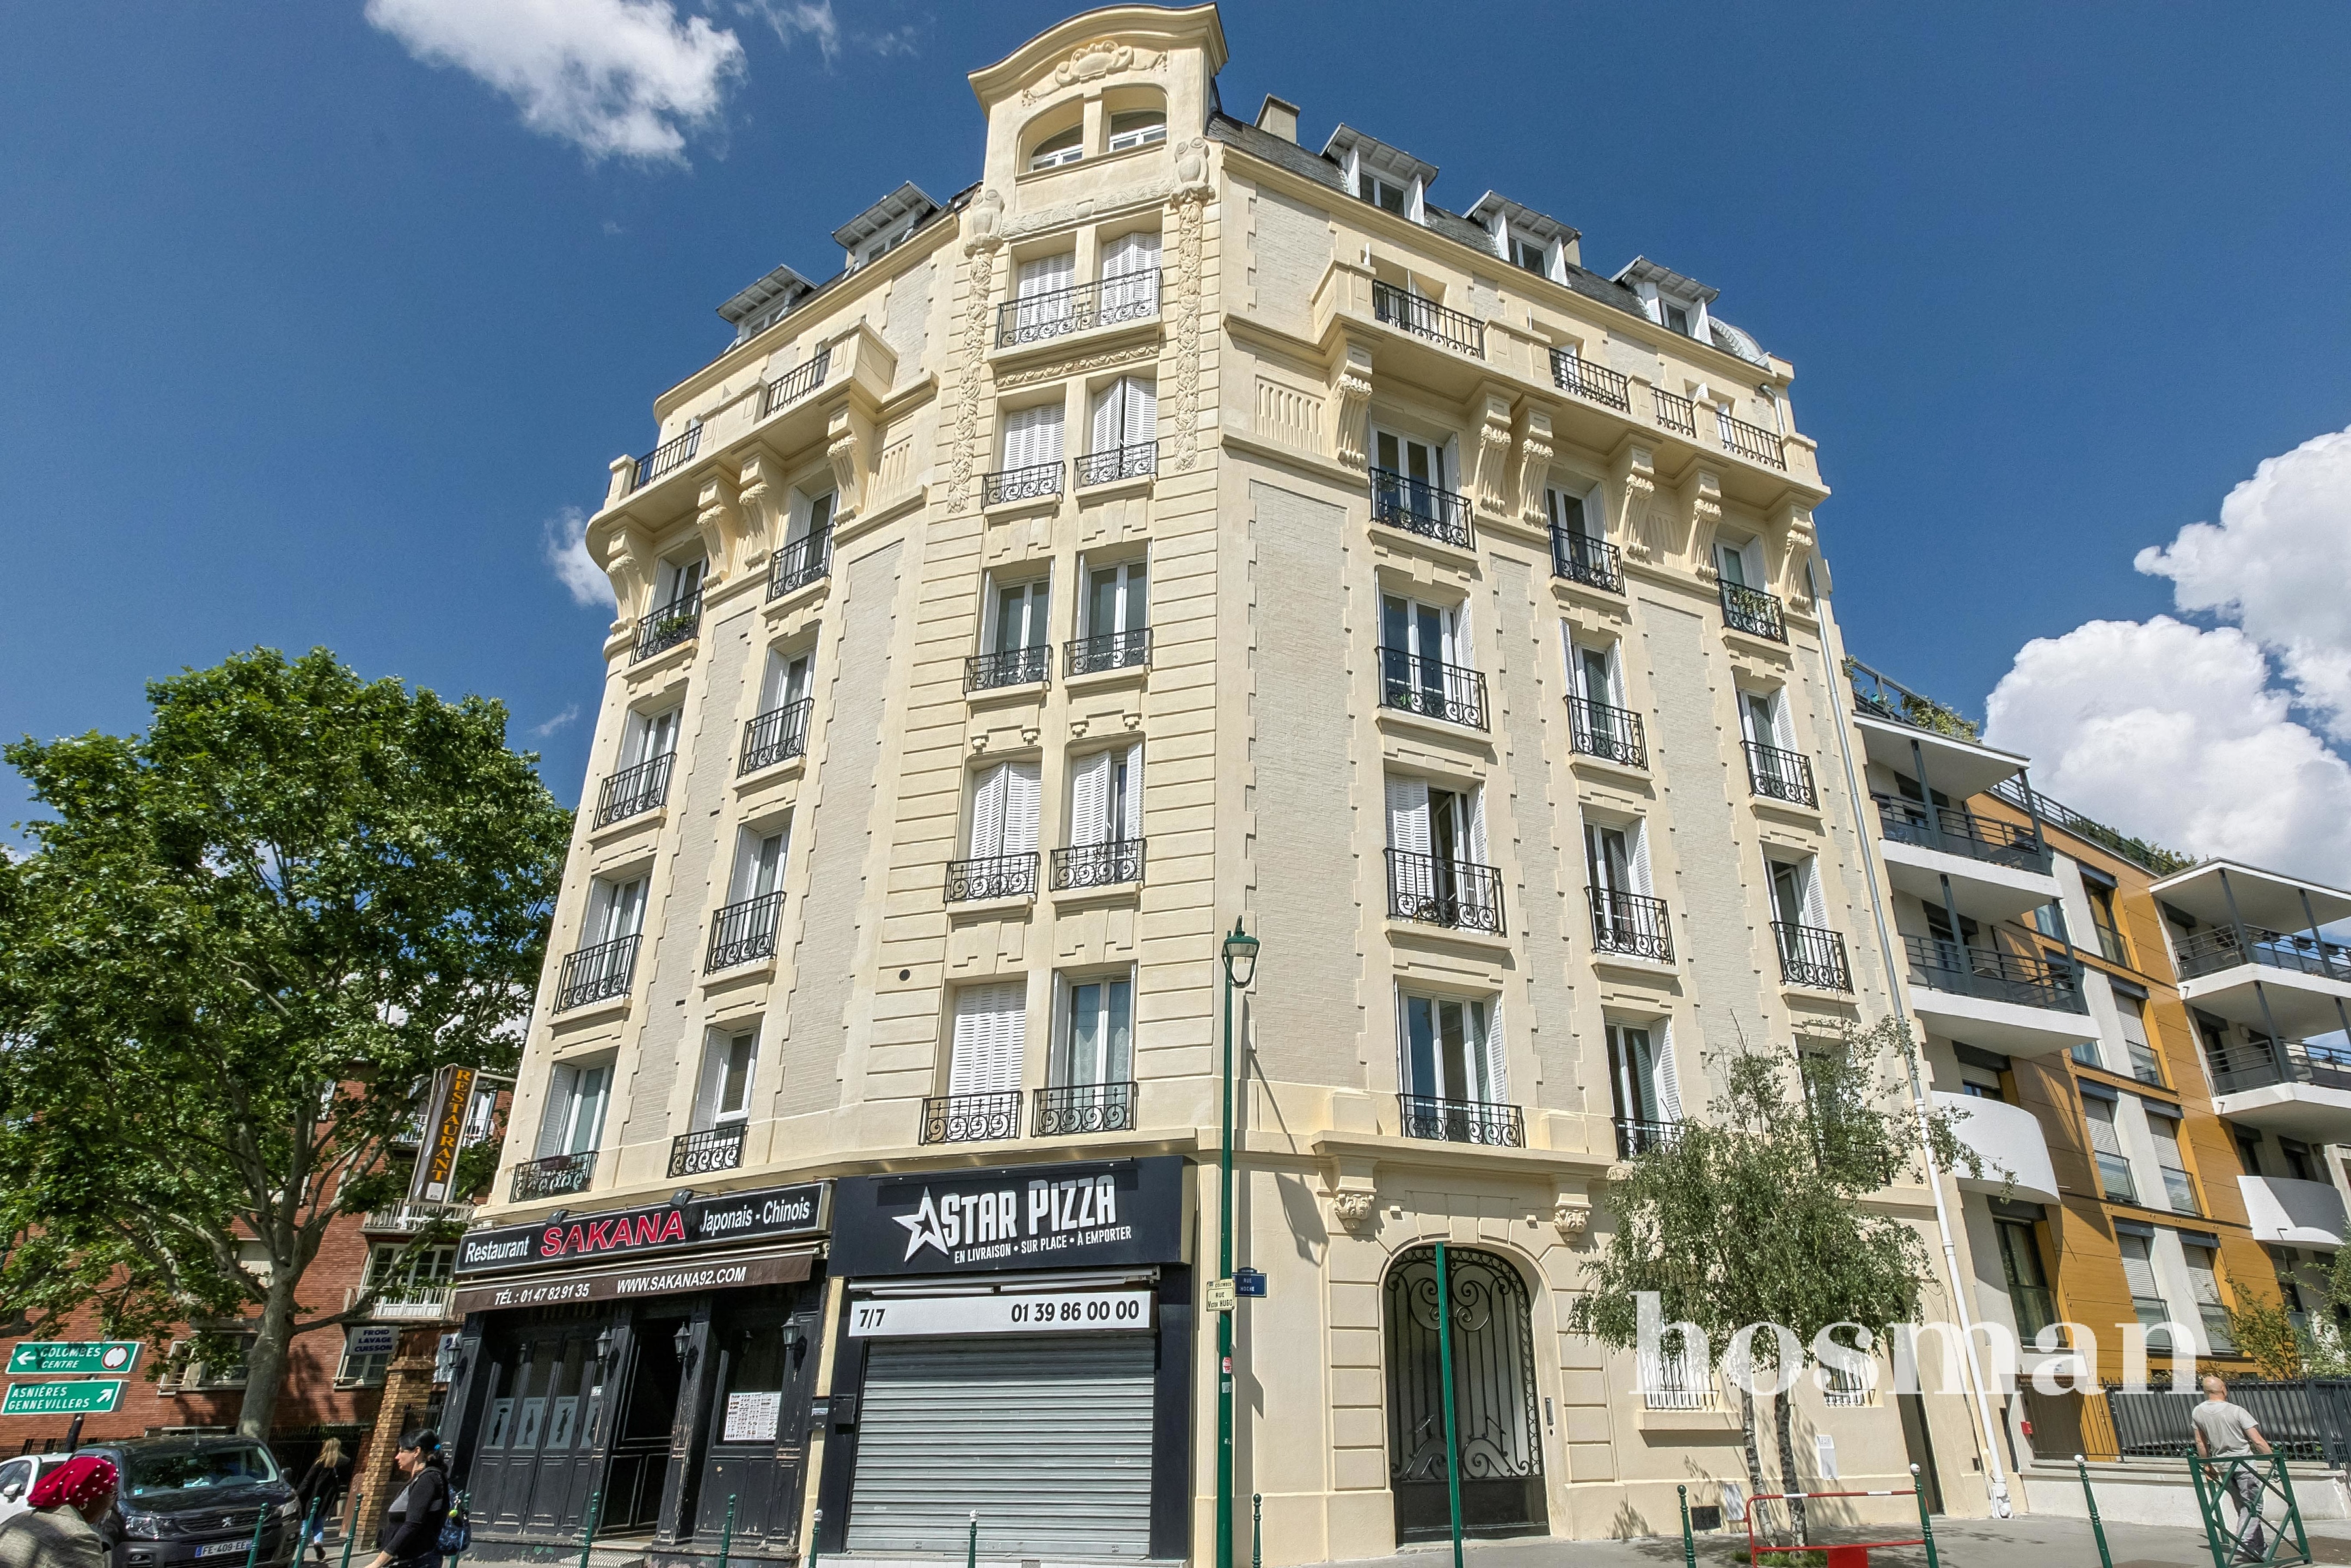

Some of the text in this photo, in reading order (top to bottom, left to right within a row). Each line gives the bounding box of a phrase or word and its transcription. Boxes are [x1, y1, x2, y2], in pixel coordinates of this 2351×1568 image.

[432, 1070, 471, 1181] RESTAURANT
[941, 1175, 1116, 1247] STAR PIZZA
[465, 1235, 530, 1263] Restaurant
[541, 1211, 685, 1257] SAKANA
[700, 1205, 752, 1236] Japonais
[763, 1197, 810, 1224] Chinois
[954, 1226, 1131, 1264] EN LIVRAISON SUR PLACE À EMPORTER
[617, 1266, 747, 1294] WWW.SAKANA92.COM
[859, 1300, 1139, 1329] 7/7 01 39 86 00 00
[40, 1347, 101, 1357] COLOMBES
[41, 1360, 79, 1368] CENTRE
